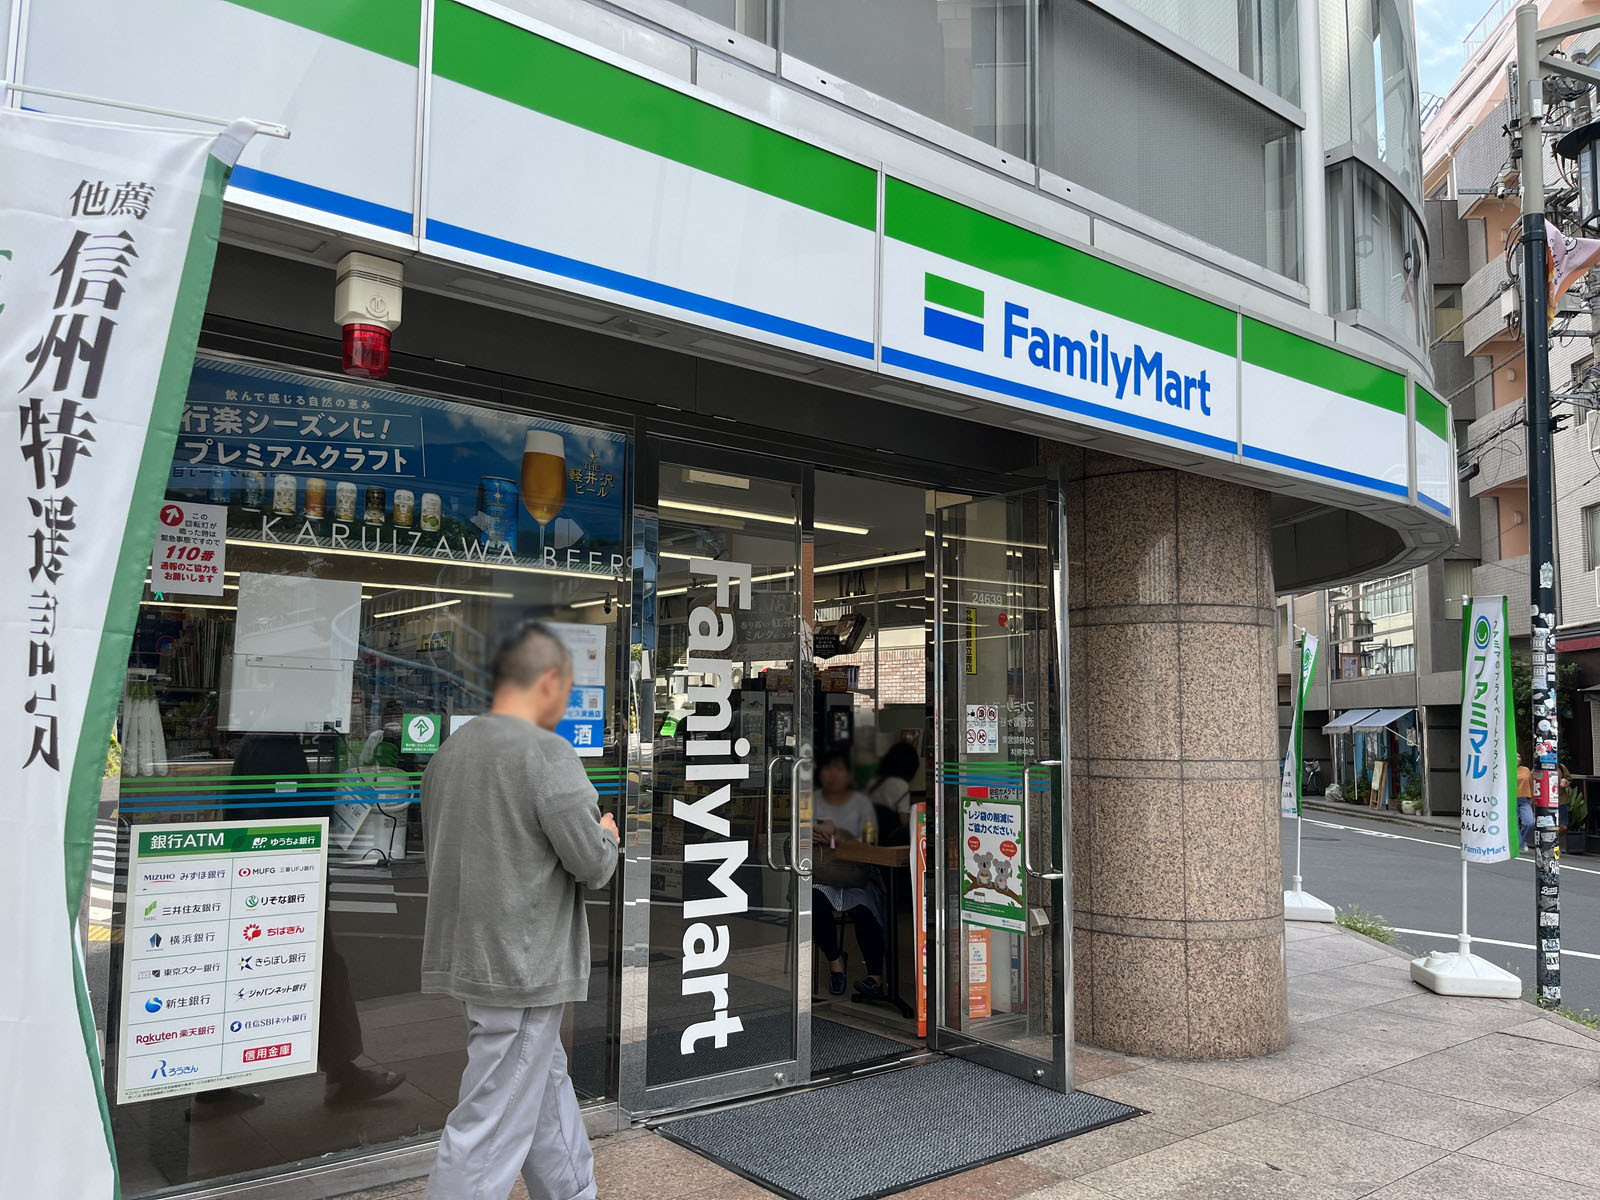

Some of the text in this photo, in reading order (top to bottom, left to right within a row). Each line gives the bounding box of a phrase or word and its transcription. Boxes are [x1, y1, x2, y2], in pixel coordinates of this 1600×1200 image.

[1004, 301, 1211, 416] FamilyMart
[225, 389, 371, 409] 飲んで感じる自然の恵み
[181, 403, 391, 440] 行楽シーズンに!
[184, 438, 407, 473] プレミアムクラフト
[568, 467, 614, 488] 軽井沢
[575, 483, 608, 497] ビール
[192, 512, 208, 520] この
[185, 520, 217, 530] 回転灯が
[160, 534, 220, 546] 緊急事態ですので
[179, 528, 216, 538] 鳴った時は
[262, 515, 623, 576] KARUIZAWA BEER
[166, 545, 215, 562] 110番
[160, 561, 219, 574] 通報のご協力を
[164, 572, 214, 583] お願いします
[972, 593, 1003, 605] 24639
[1465, 655, 1489, 779] ファミマル
[573, 724, 593, 745] 酒
[673, 558, 751, 1056] FamilyMart
[968, 810, 1014, 823] レジ袋の削減に
[968, 822, 1016, 837] ご協力ください。
[151, 832, 225, 850] 銀行ATM
[270, 836, 315, 847] ゆうちょ銀行
[1463, 843, 1506, 856] FamilyMart
[144, 870, 225, 881] MIZUHO みずほ銀行
[252, 867, 276, 875] MUFG
[261, 894, 306, 906] りそな銀行
[162, 903, 221, 916] 三井住友銀行
[169, 932, 216, 945] 横浜銀行
[255, 953, 306, 967] きらぼし銀行
[164, 963, 220, 977] 東京スター銀行
[249, 983, 307, 998] ジャパンネット銀行
[166, 994, 211, 1009] 新生銀行
[244, 1012, 307, 1029] 住信SBIネット銀行
[136, 1025, 215, 1044] Rakuten 楽天銀行
[245, 1044, 291, 1061] 信用金庫
[168, 1064, 199, 1076] ろうきん
